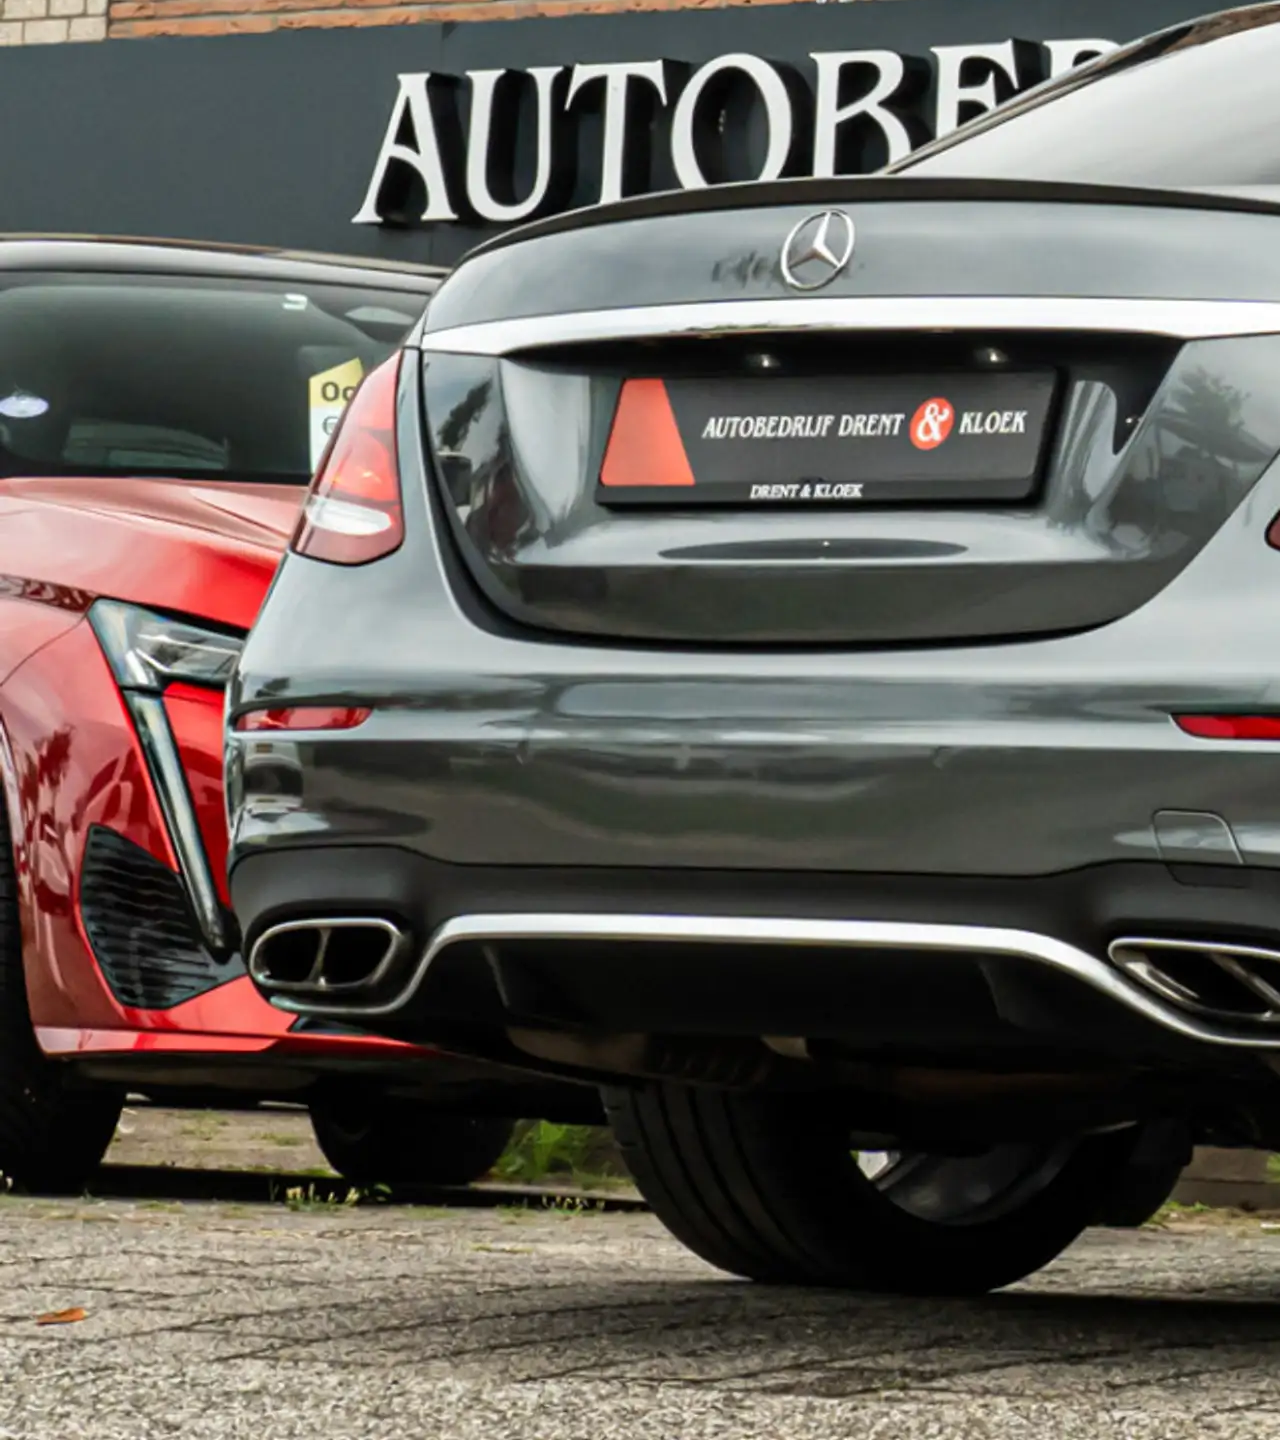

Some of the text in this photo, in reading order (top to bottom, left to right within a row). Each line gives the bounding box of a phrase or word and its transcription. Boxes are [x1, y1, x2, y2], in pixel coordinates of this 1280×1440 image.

[351, 38, 1122, 225] AUTOBE
[701, 402, 1029, 443] AUTOBEDRIJF DRENT & KLOEK
[749, 482, 864, 500] DRENT & KLOEK
